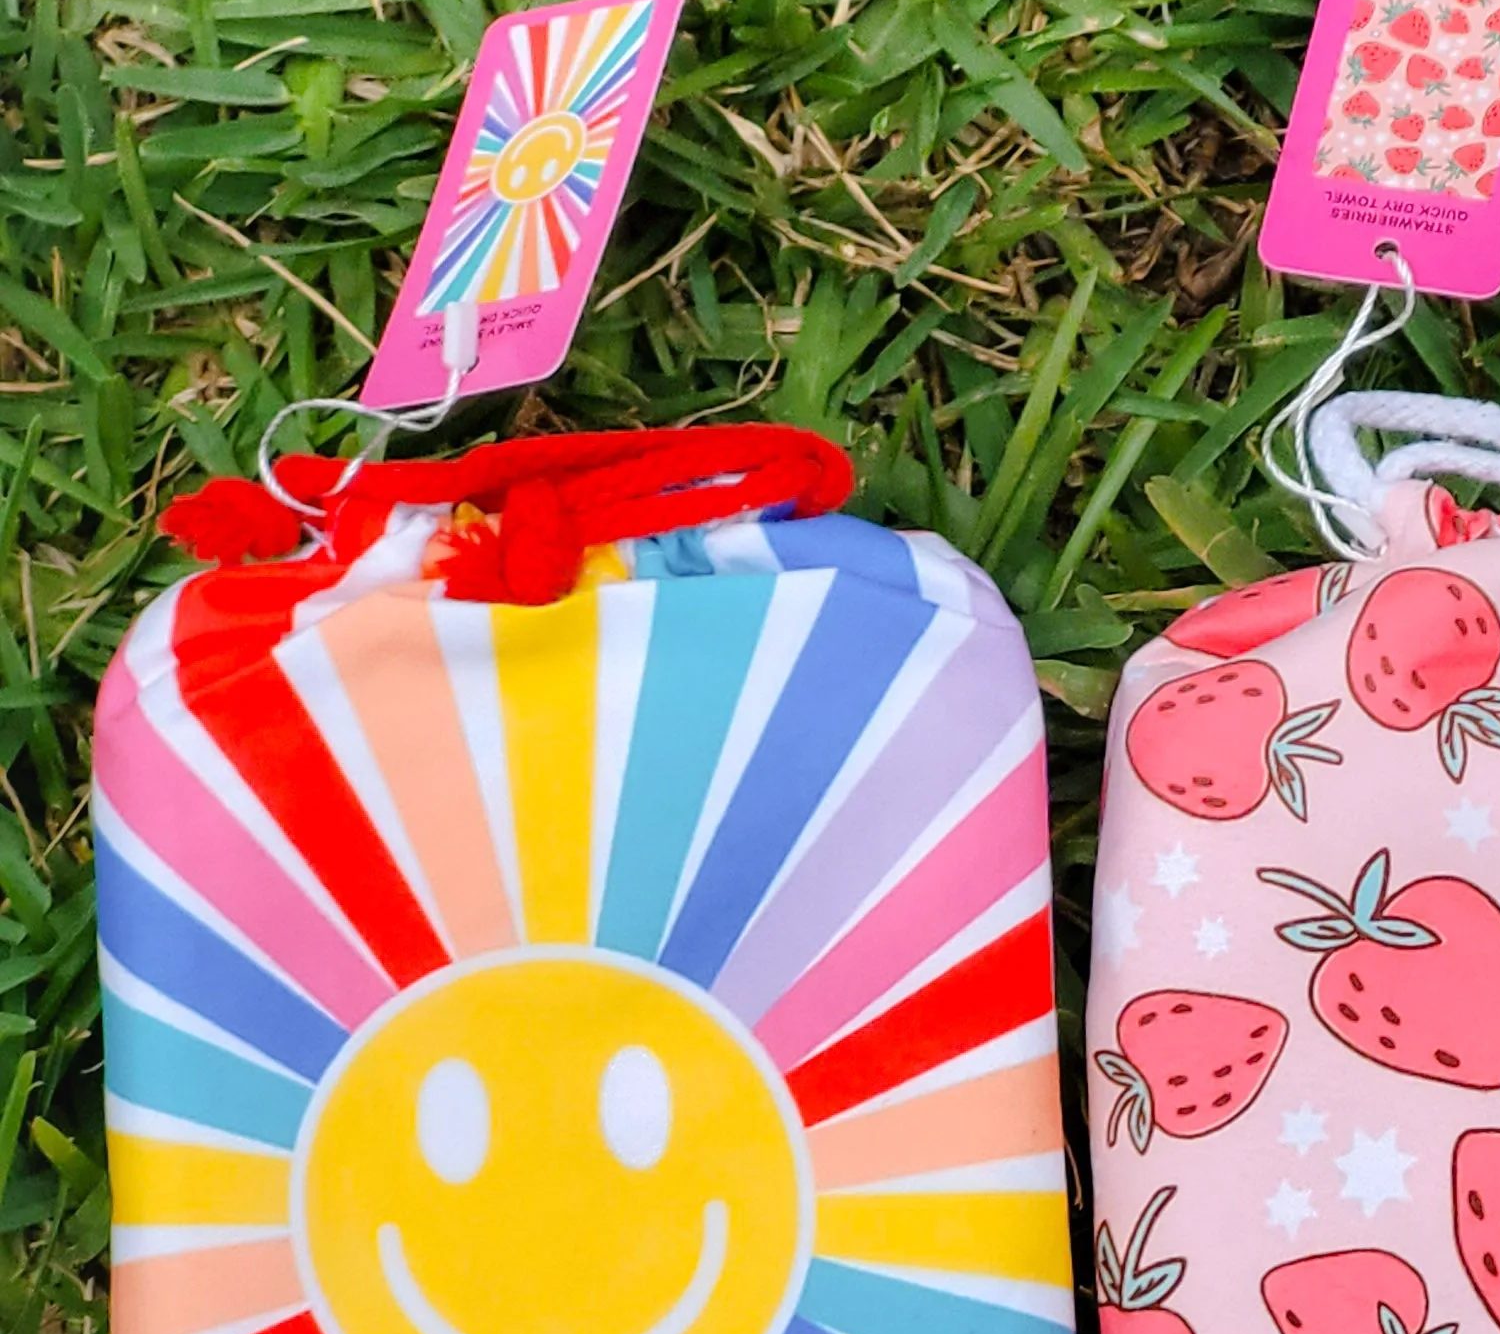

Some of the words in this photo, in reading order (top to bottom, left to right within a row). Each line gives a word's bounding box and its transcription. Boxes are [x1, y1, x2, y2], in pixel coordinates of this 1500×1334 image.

[1324, 190, 1378, 209] TOWEL
[1383, 197, 1414, 214] DRY
[1330, 207, 1456, 236] STRAWBERRIES
[1420, 205, 1469, 222] QUICK
